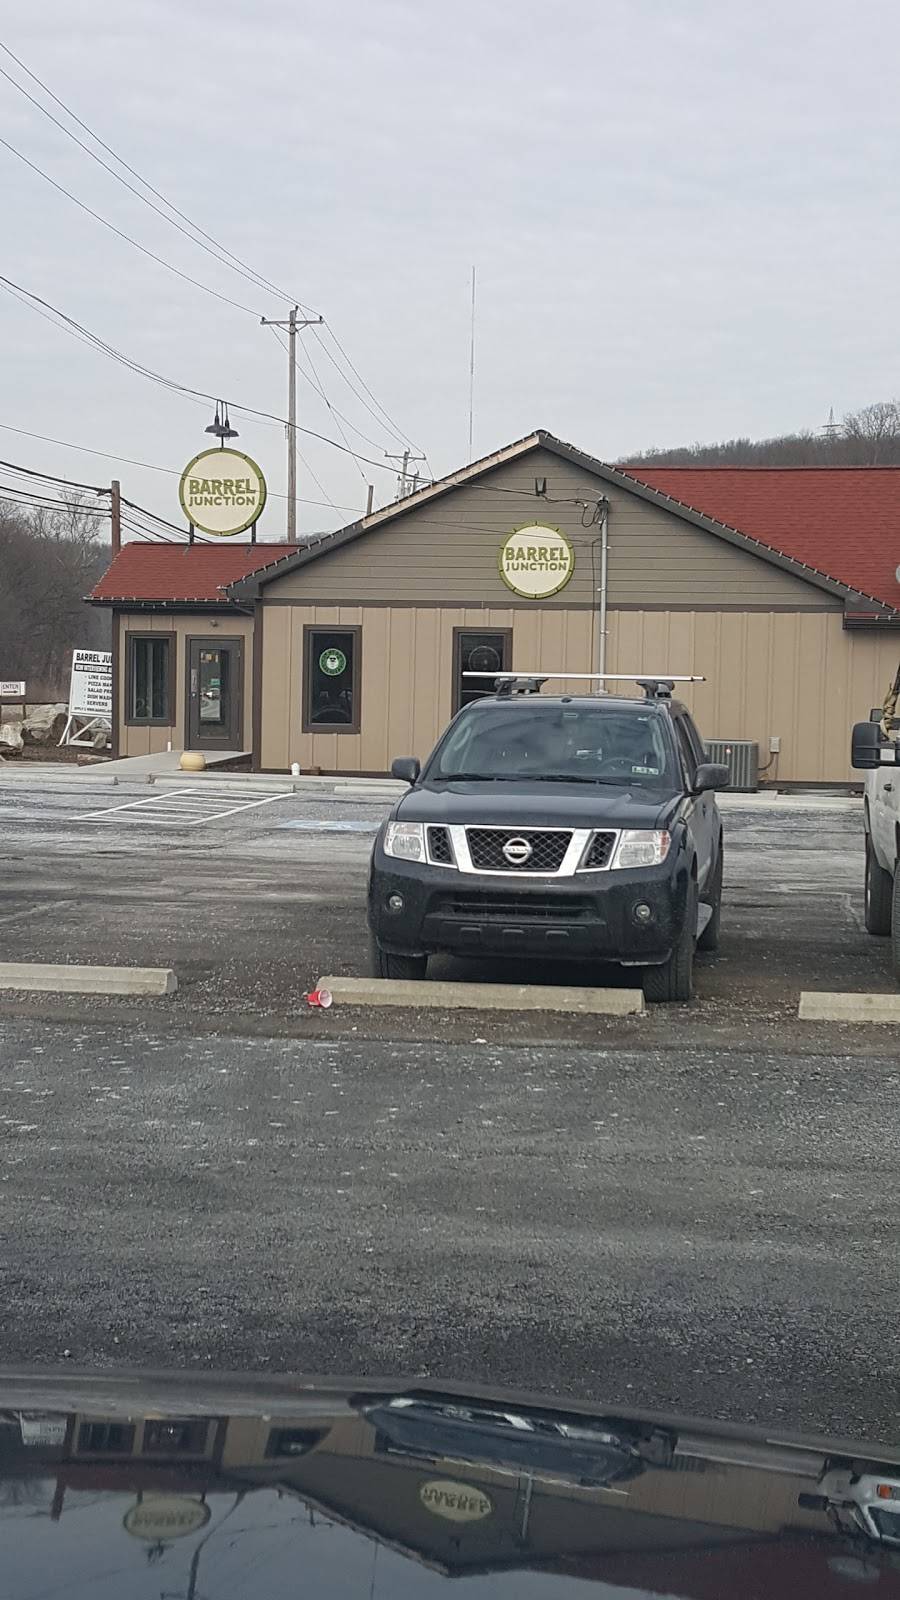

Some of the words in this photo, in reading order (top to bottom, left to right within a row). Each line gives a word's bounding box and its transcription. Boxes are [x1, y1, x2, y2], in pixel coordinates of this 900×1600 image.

[189, 479, 257, 496] BARREL
[188, 496, 255, 506] JUNCTION
[505, 547, 568, 562] BARREL
[505, 562, 567, 571] JUNCTION
[76, 653, 101, 663] BARREL
